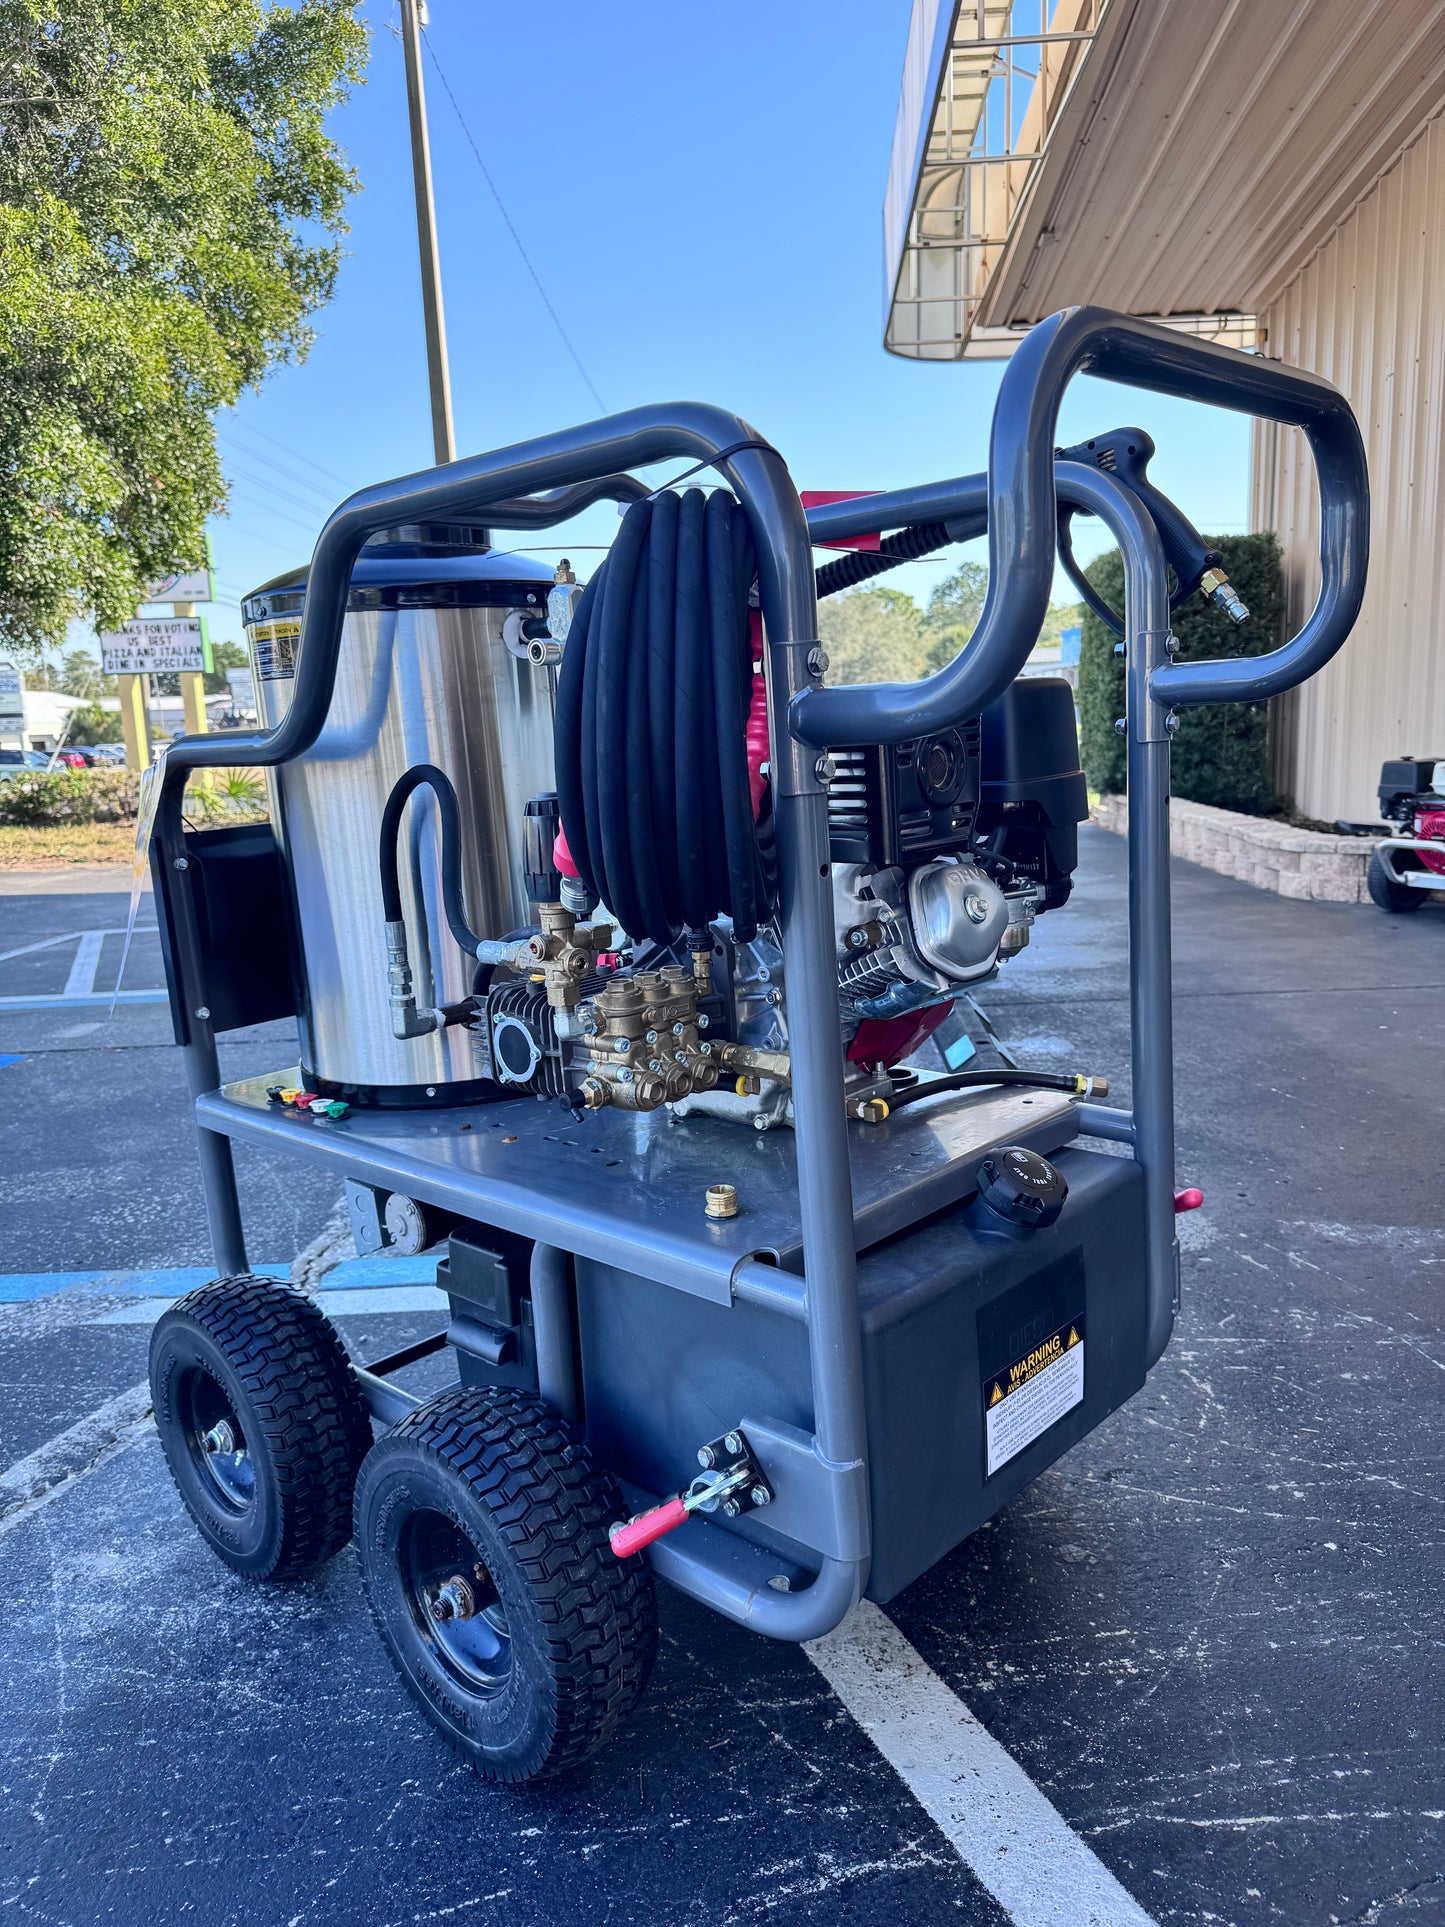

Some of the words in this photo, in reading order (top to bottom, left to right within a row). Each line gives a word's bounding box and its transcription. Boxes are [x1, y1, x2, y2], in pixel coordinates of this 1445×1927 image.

[144, 624, 161, 634] FOR
[165, 623, 200, 633] VOTING
[127, 637, 139, 646] US
[148, 636, 172, 646] BEST
[103, 647, 134, 658] PIZZA
[136, 647, 156, 657] AND
[161, 646, 202, 657] ITALIAN
[107, 659, 131, 670] DINE
[134, 659, 145, 669] IN
[152, 658, 200, 669] SPECIALS
[947, 867, 980, 885] OHV
[1009, 1335, 1060, 1382] WARNING
[1007, 1378, 1021, 1395] AVIS
[1024, 1346, 1065, 1382] ADVERTENCIA
